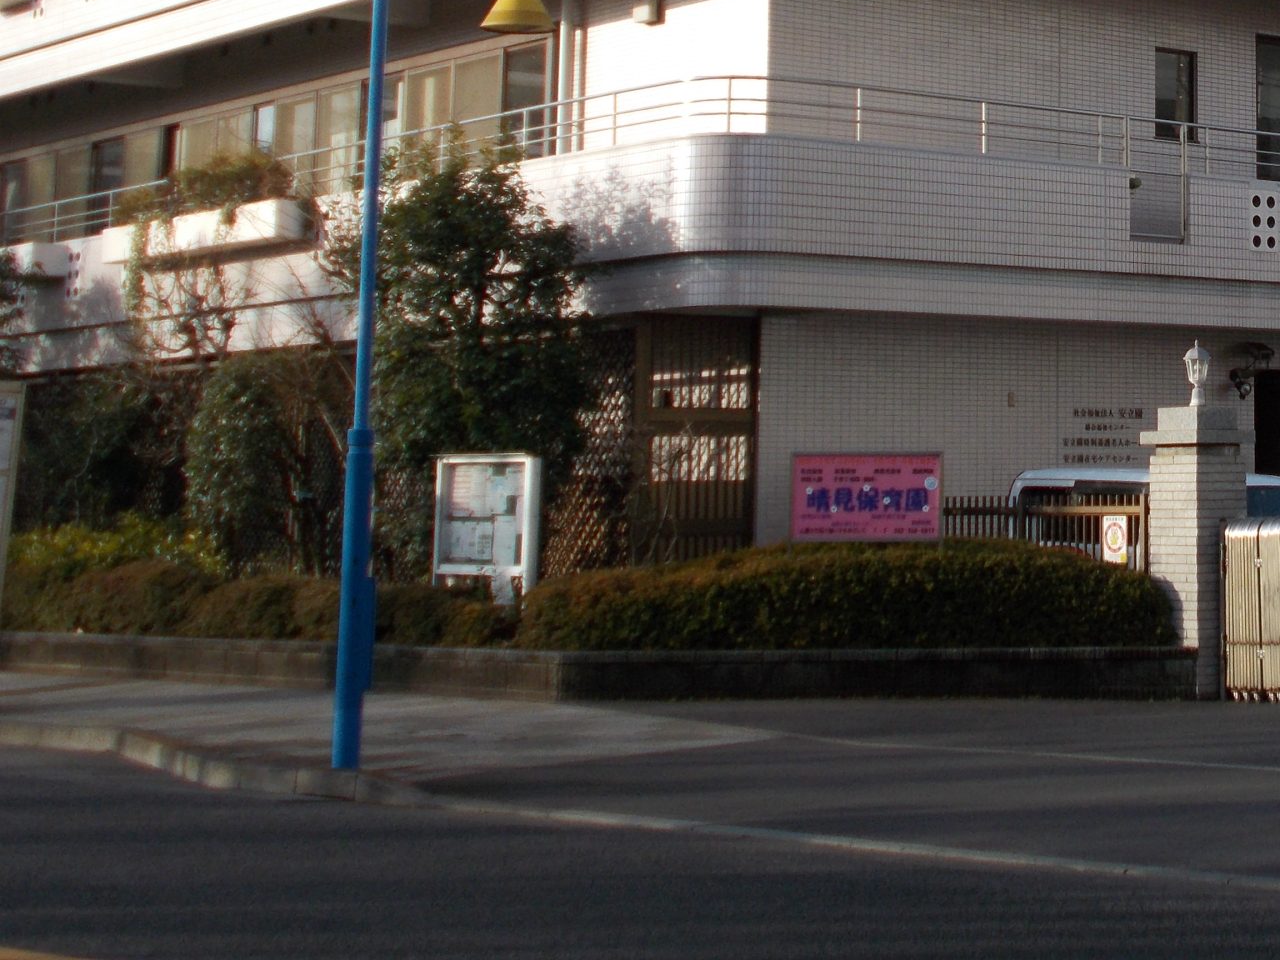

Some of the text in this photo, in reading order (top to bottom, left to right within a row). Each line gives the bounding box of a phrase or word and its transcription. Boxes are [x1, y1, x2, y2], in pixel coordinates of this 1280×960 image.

[806, 486, 929, 513] 晴見保育園
